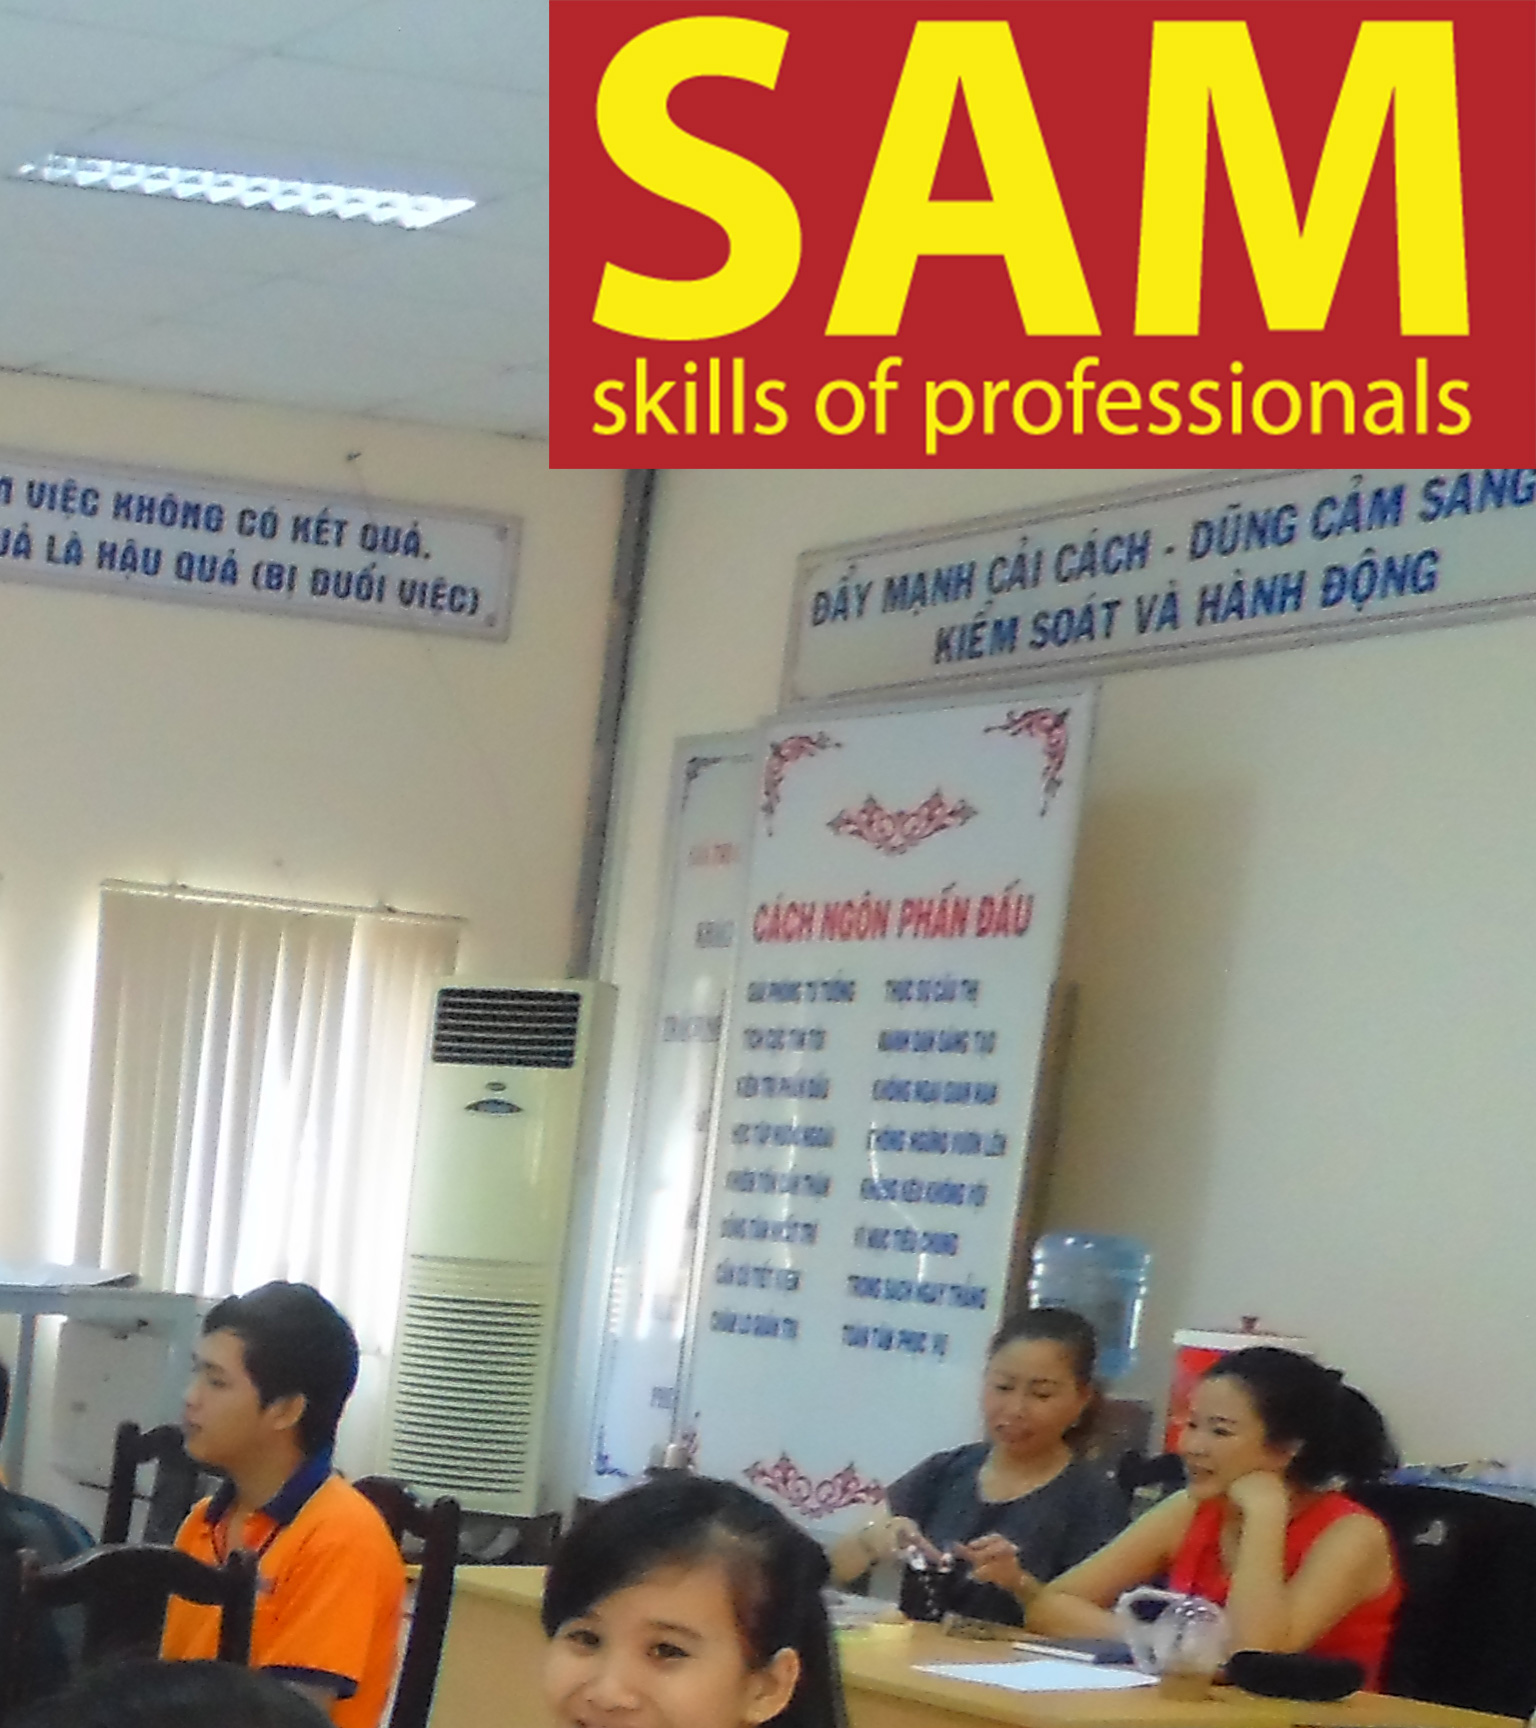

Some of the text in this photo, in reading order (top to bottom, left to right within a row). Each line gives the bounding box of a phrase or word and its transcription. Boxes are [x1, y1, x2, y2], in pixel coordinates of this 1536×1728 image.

[46, 530, 84, 567] LÀ
[112, 488, 226, 535] KHÔNG
[236, 502, 279, 542] CÓ
[290, 506, 350, 548] KẾT
[881, 560, 977, 616] MẠNH
[987, 535, 1044, 596] CẢI
[1054, 530, 1152, 584] CÁCH
[1310, 474, 1407, 541] CẢM
[1029, 592, 1122, 651] SOÁT
[1135, 578, 1181, 636] VÀ
[1196, 566, 1306, 627] HÀNH
[1319, 546, 1440, 613] ĐỘNG
